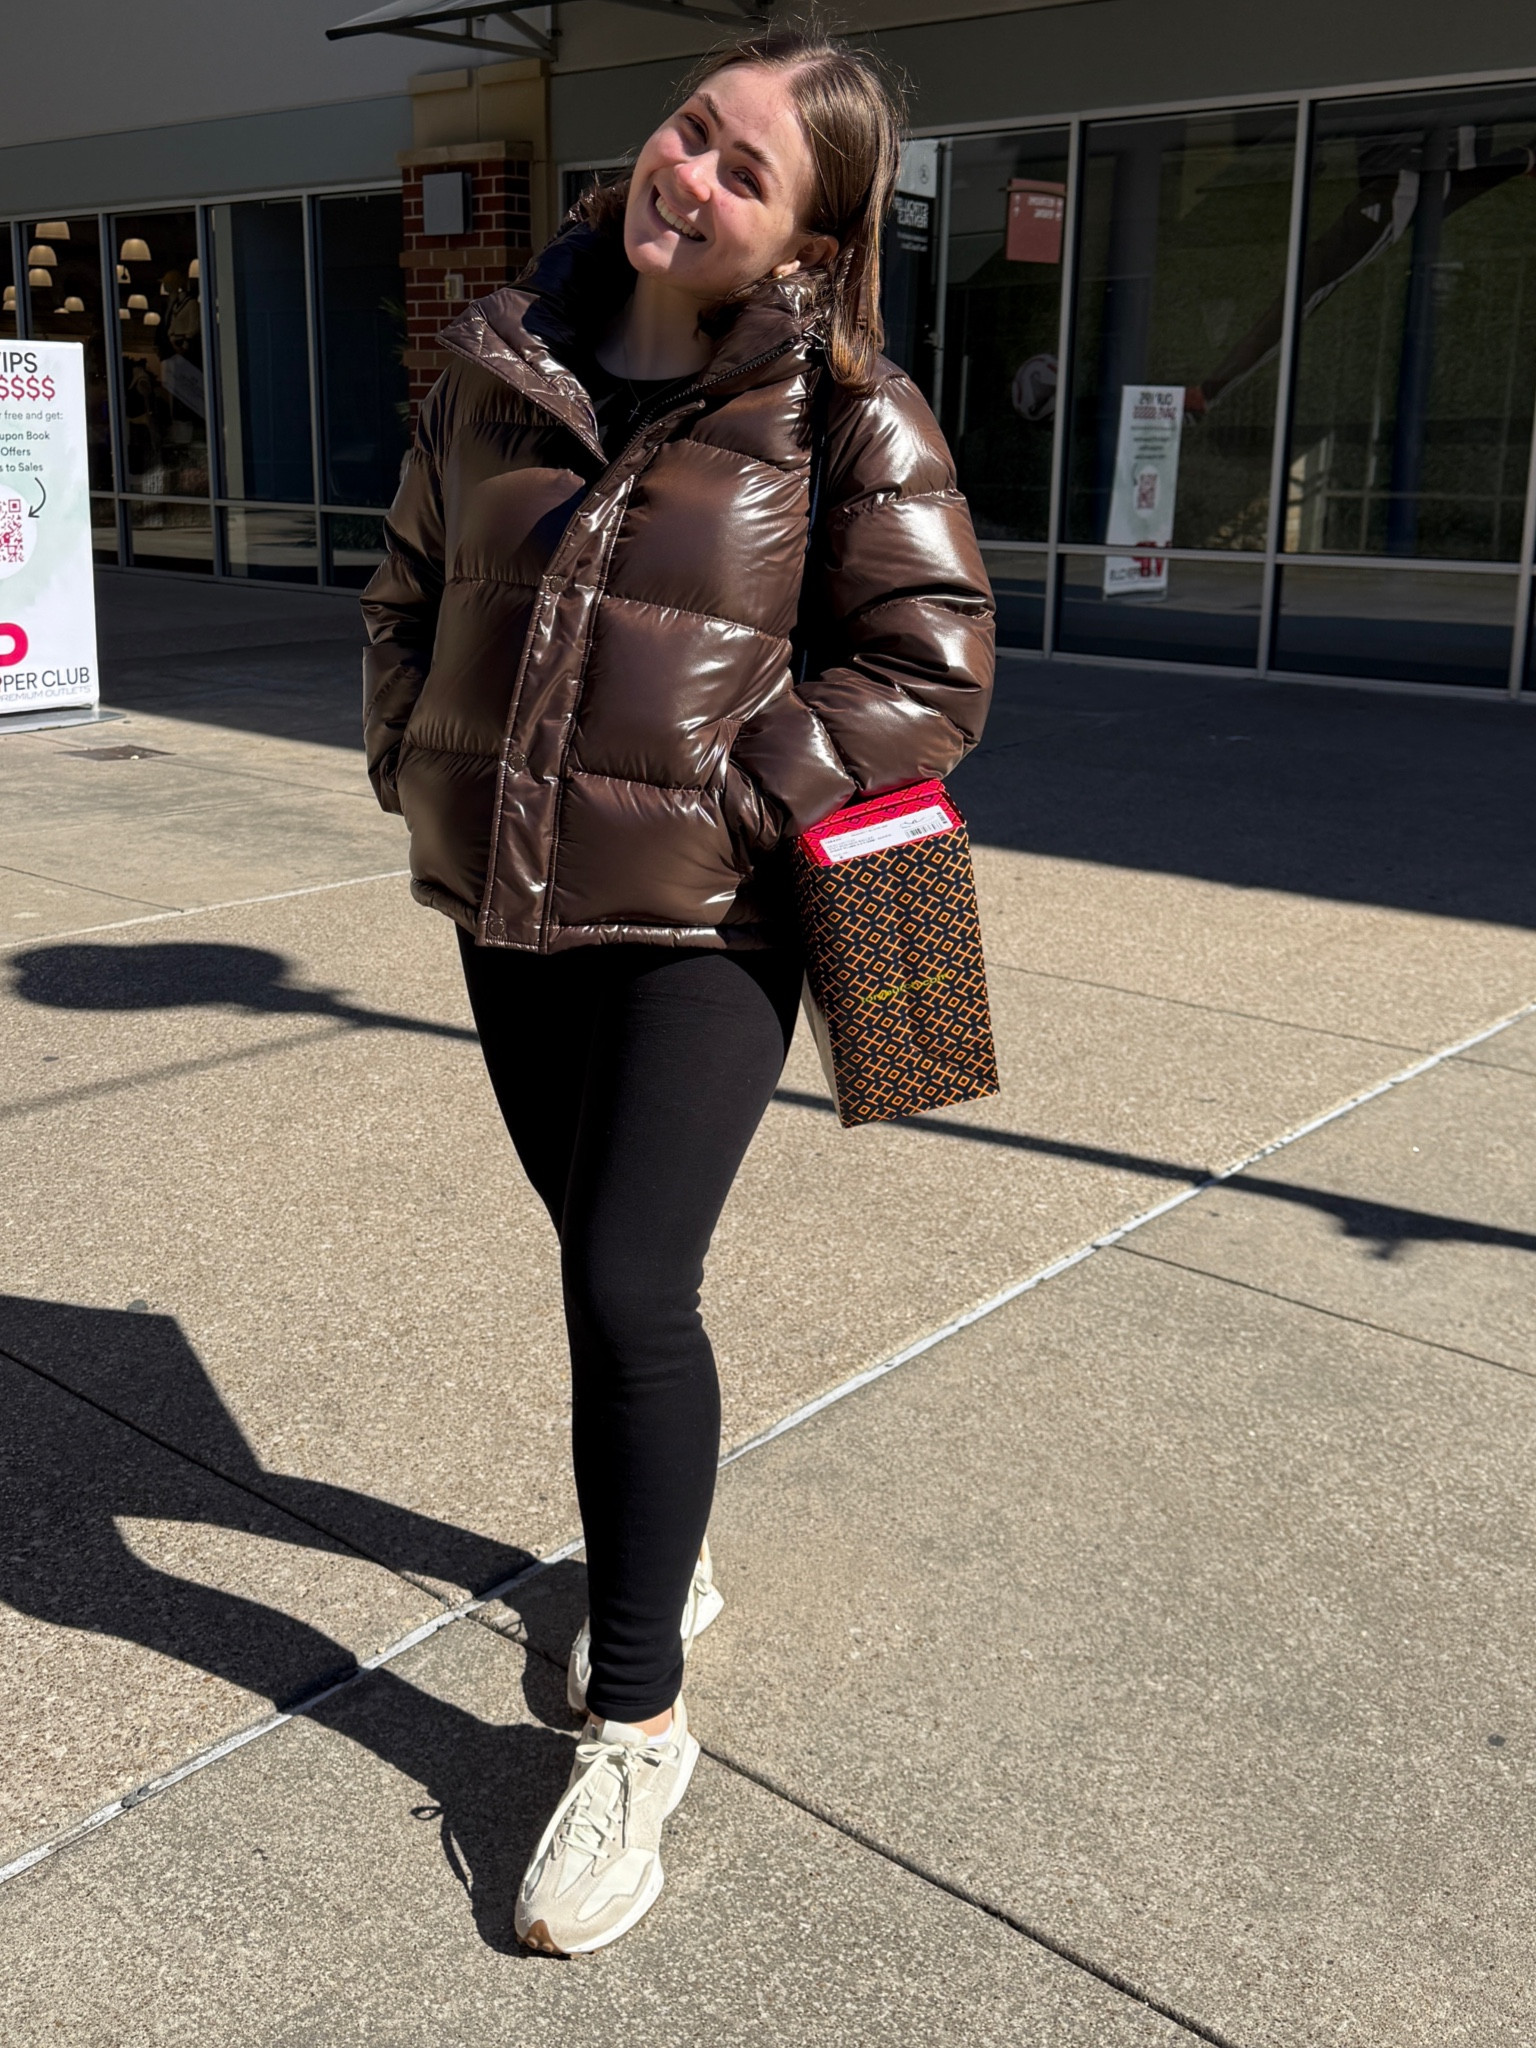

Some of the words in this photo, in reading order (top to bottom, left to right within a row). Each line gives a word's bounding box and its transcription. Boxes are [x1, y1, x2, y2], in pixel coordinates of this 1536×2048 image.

[0, 352, 38, 373] IPS
[4, 410, 23, 420] free
[26, 411, 43, 420] and
[45, 411, 63, 422] get:
[26, 431, 50, 440] Book
[1, 446, 31, 456] Offers
[6, 464, 16, 472] to
[18, 462, 43, 472] Sales
[0, 672, 37, 692] PER
[41, 667, 90, 687] CLUB
